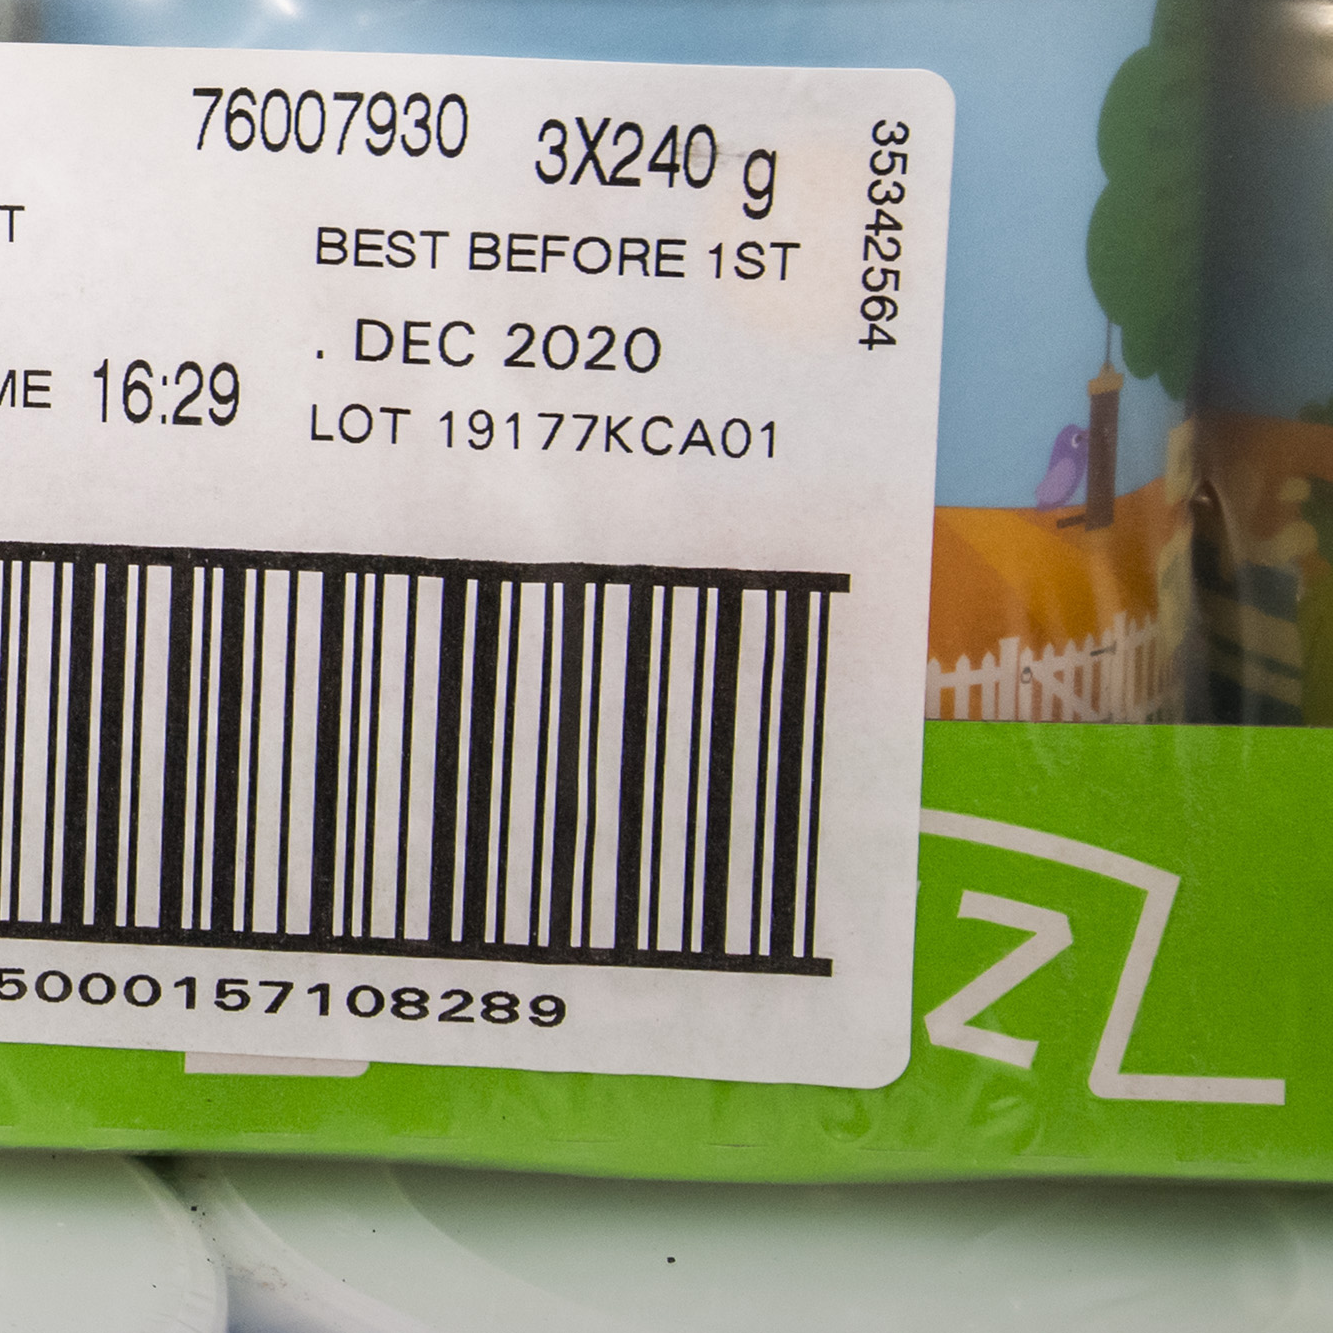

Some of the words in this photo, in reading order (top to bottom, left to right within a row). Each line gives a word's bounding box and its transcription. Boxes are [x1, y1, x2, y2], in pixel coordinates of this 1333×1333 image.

[191, 87, 469, 159] 76007930
[534, 117, 717, 188] 3X240
[741, 147, 777, 218] g
[316, 227, 448, 269] BEST
[469, 233, 686, 279] BEFORE
[709, 240, 800, 282] 1ST
[857, 119, 910, 351] 35342564
[355, 319, 475, 368] DEC
[504, 324, 662, 374] 2020
[93, 359, 240, 426] 16:29
[310, 403, 410, 444] LOT
[440, 410, 778, 459] 19177KCA01
